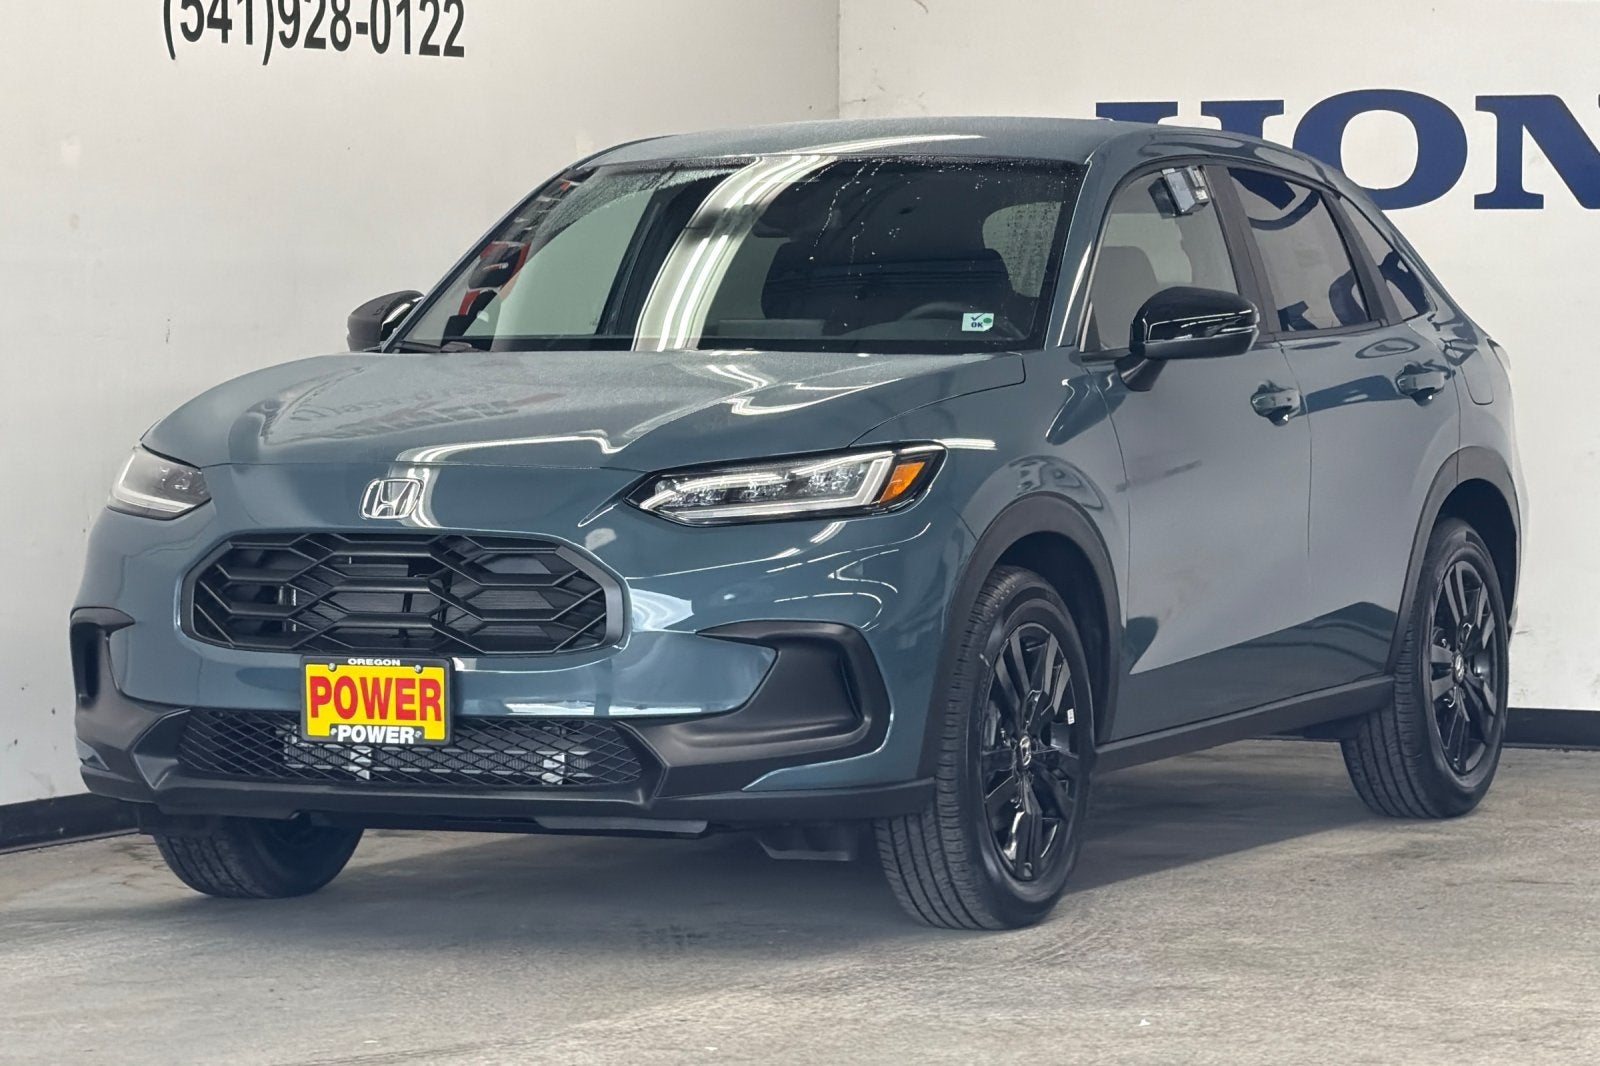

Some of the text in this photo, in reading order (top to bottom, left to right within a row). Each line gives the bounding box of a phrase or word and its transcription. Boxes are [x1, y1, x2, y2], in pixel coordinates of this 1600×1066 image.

[163, 0, 465, 65] (541)928-0122
[1095, 88, 1600, 211] ON
[347, 658, 401, 666] OREGON
[310, 675, 442, 721] POWER
[337, 725, 415, 744] POWER
